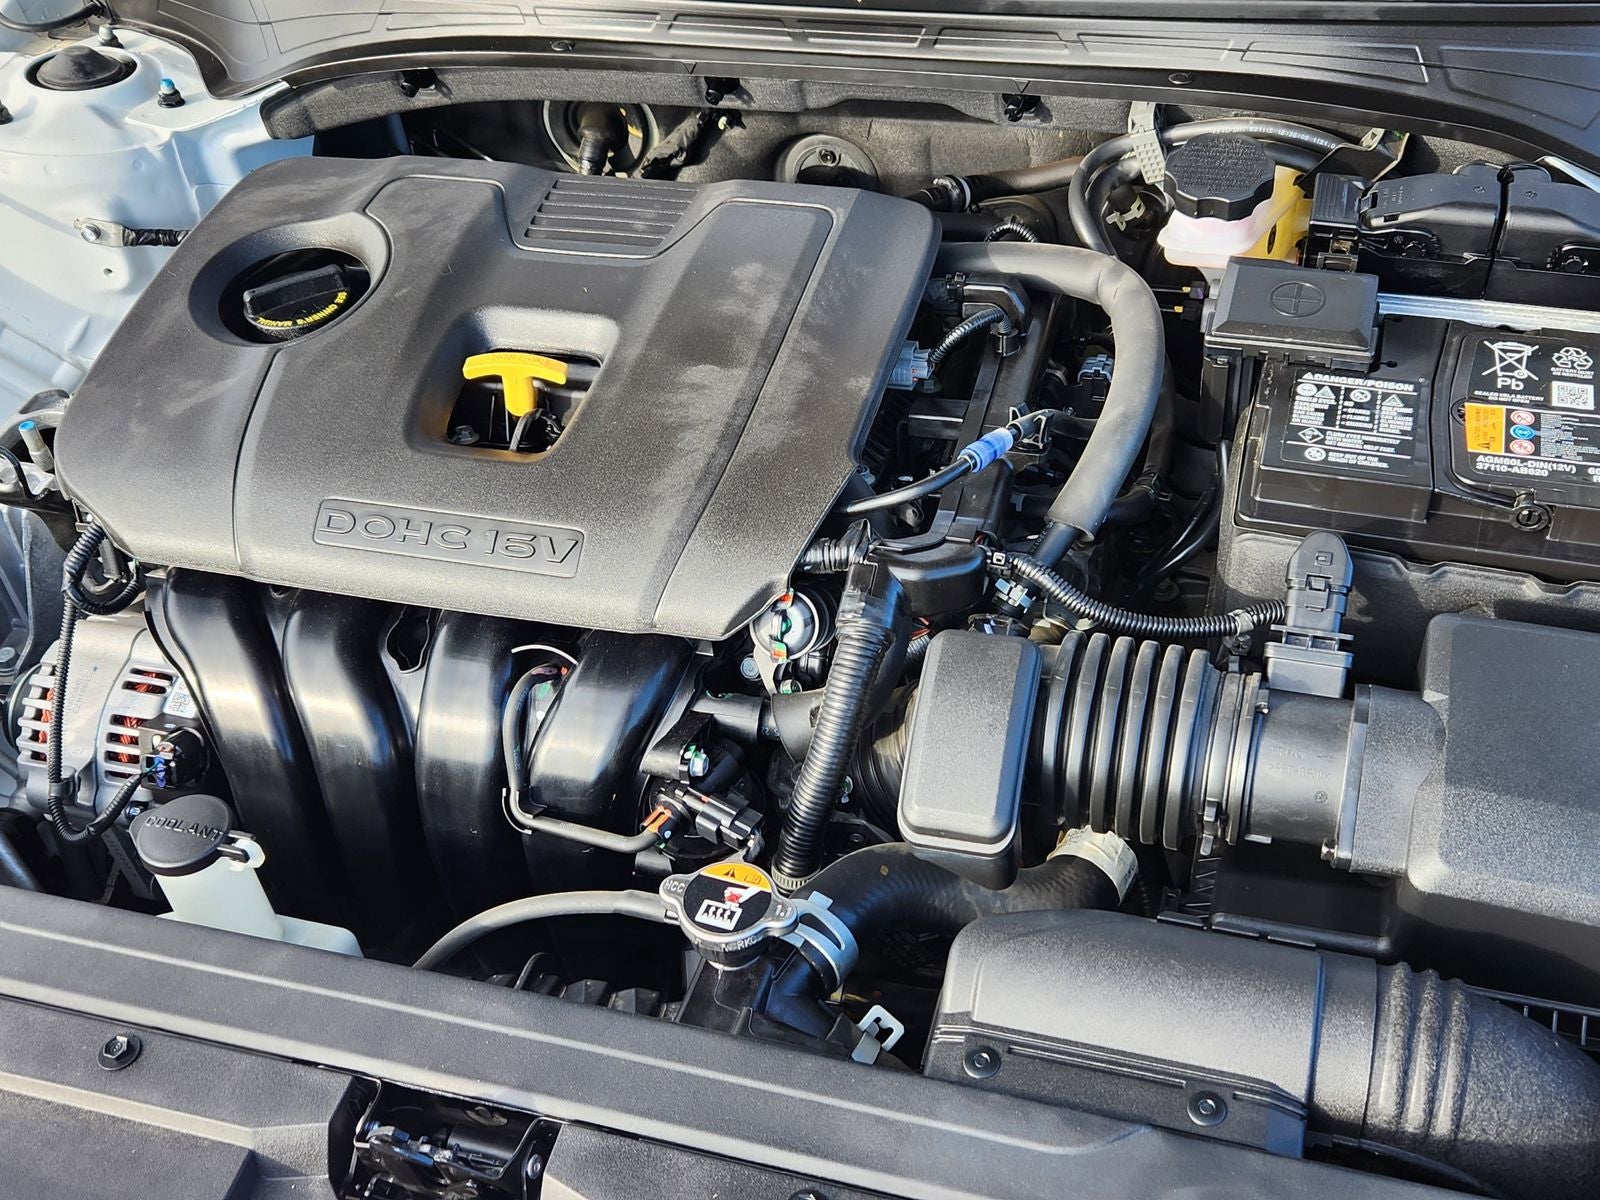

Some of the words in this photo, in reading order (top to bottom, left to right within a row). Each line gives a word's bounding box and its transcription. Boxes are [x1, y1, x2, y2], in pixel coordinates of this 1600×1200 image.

[334, 291, 347, 304] SEE
[296, 303, 338, 324] OWNER'S
[256, 316, 293, 327] MANUAL
[1313, 373, 1415, 391] DANGER/POISON
[1497, 377, 1524, 390] Pb
[1345, 421, 1373, 429] SMOKING
[1476, 455, 1576, 474] AGM60L-DIN(12V)
[319, 507, 471, 550] DOHC
[484, 529, 579, 564] 16V
[145, 816, 223, 841] COOLANT
[663, 880, 686, 893] HCC
[775, 904, 792, 918] 1.1
